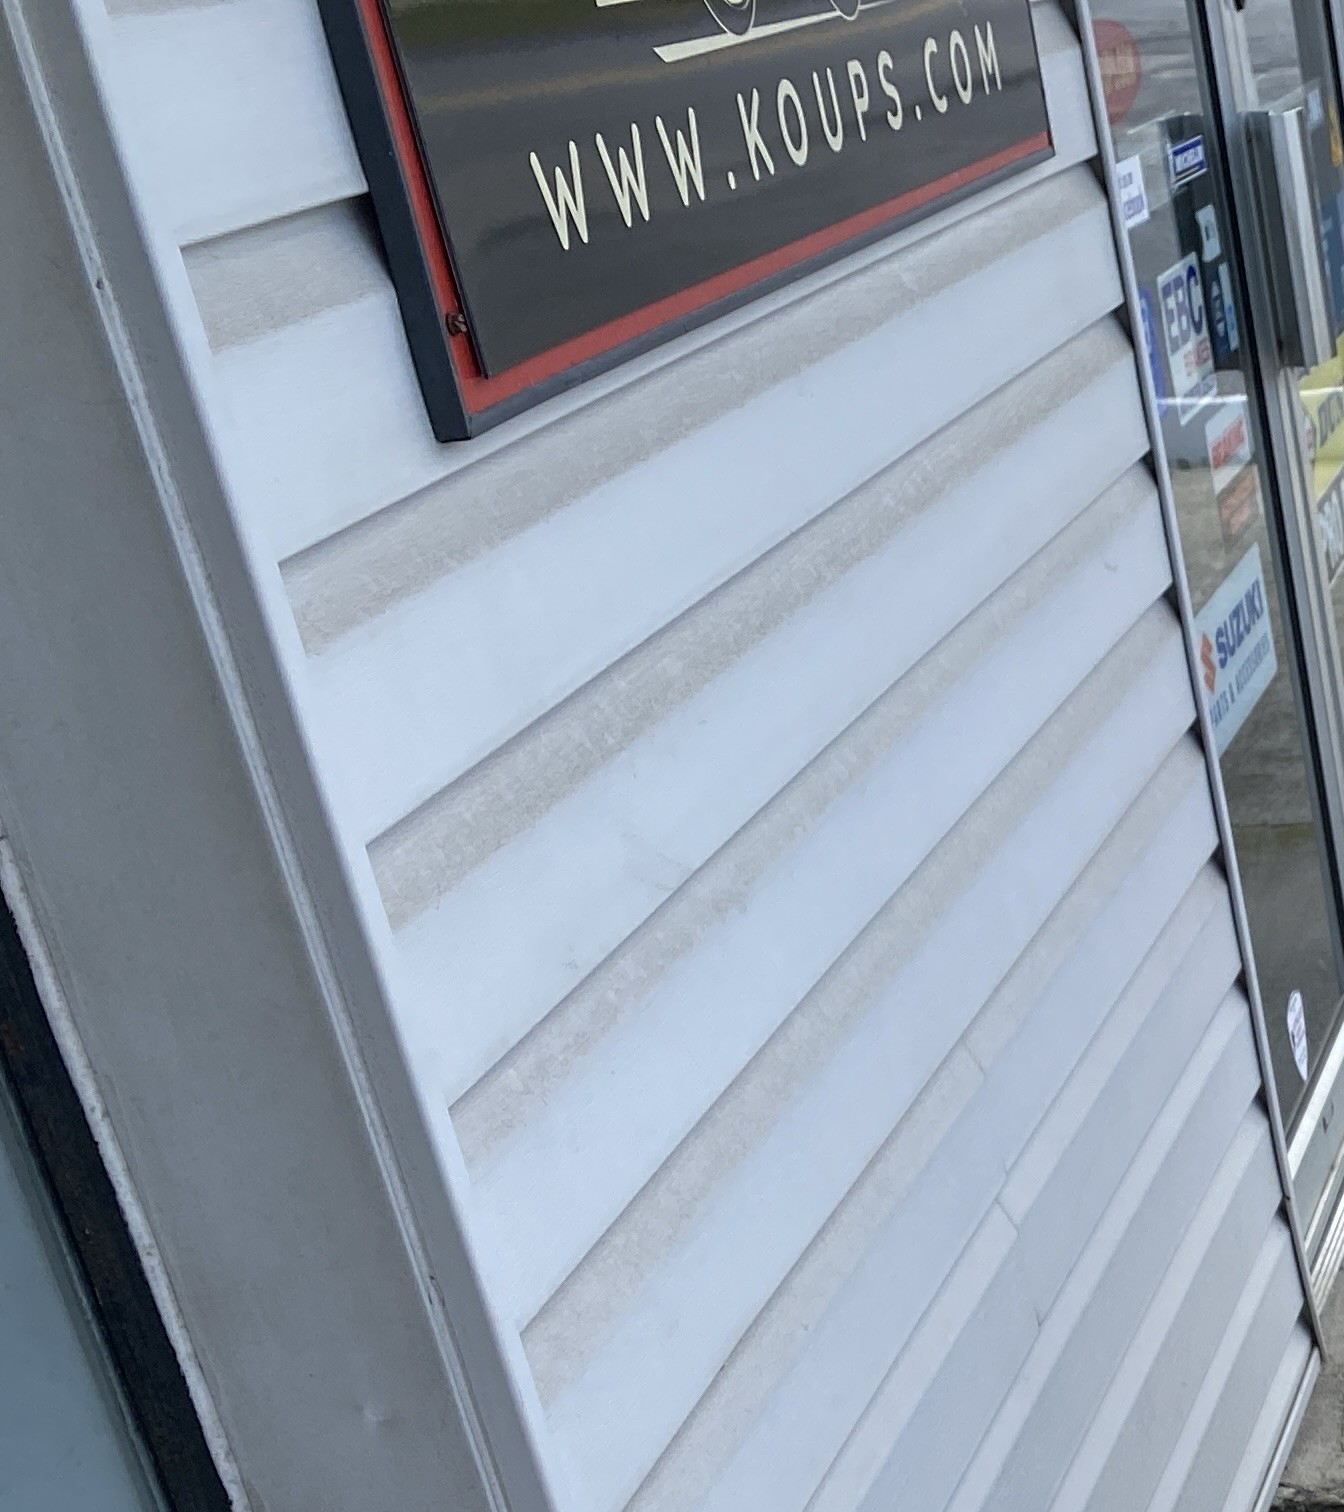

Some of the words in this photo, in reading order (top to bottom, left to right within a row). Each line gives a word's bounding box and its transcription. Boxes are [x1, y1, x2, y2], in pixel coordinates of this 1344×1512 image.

[529, 20, 1002, 250] WWW.KOUPS.COM
[1162, 265, 1203, 356] EBC
[1216, 577, 1264, 669] SUZUKI
